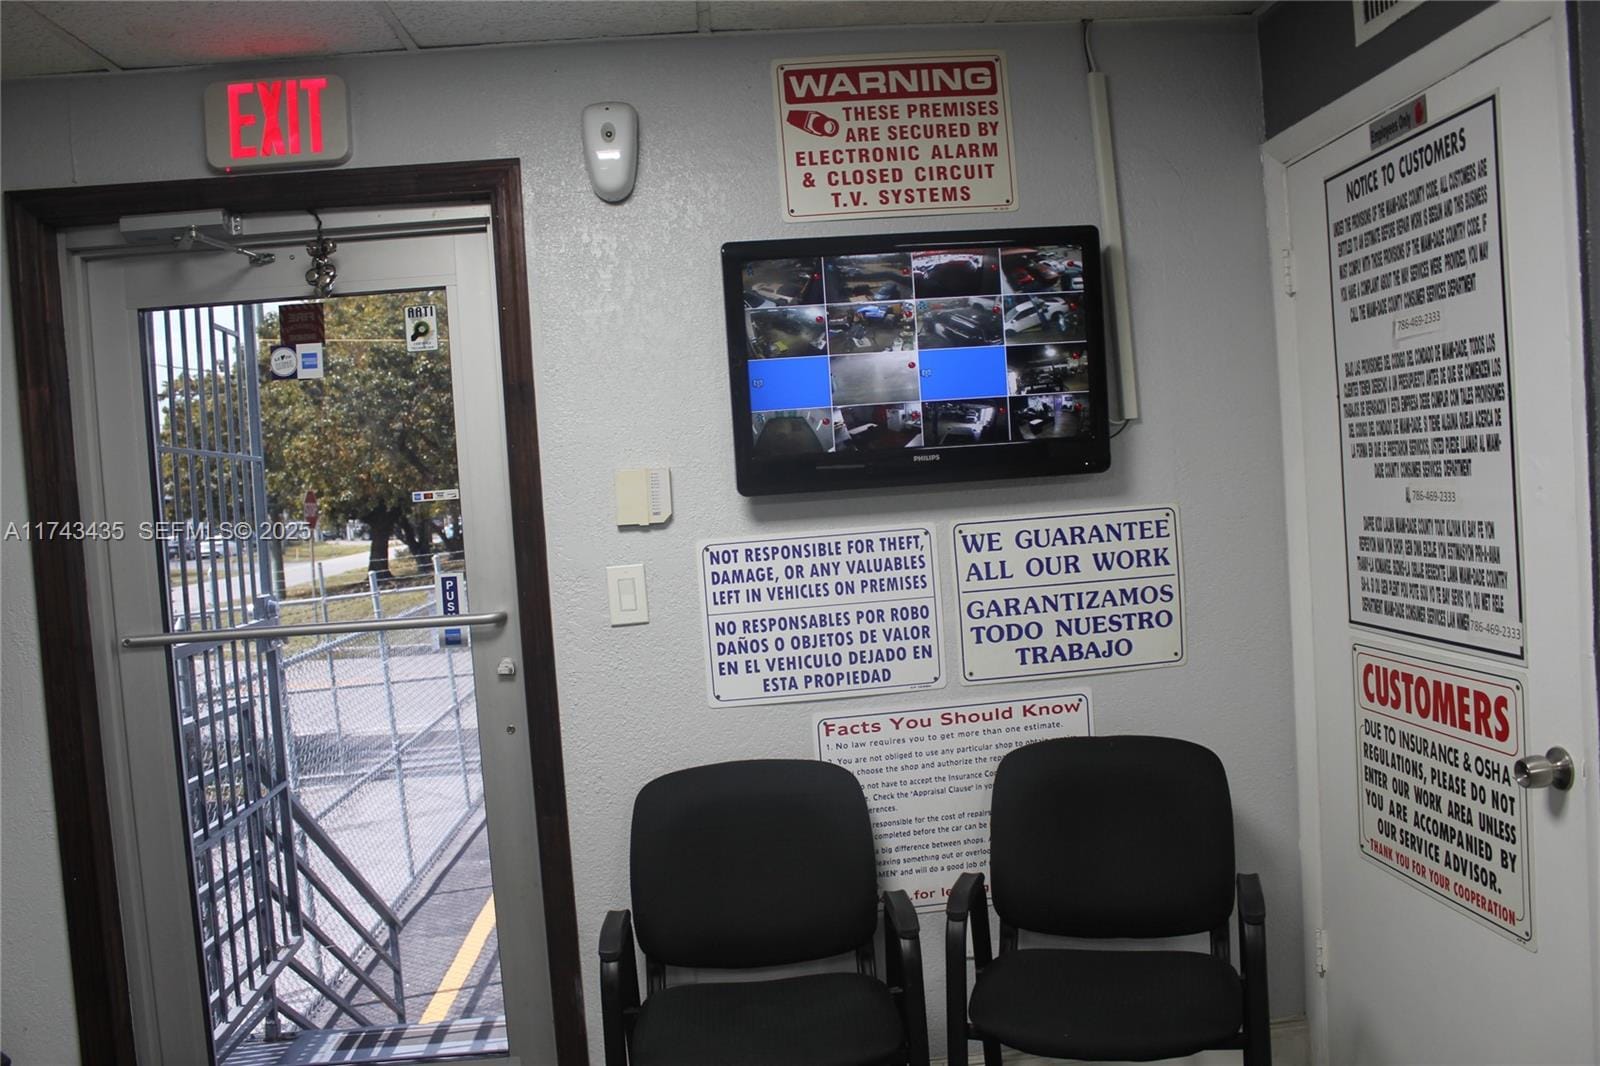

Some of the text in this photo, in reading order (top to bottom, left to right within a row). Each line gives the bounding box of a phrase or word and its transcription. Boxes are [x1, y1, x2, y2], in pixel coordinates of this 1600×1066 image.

[789, 67, 991, 98] WARNING
[227, 78, 328, 159] EXIT
[842, 100, 998, 121] THESE PREMISES
[845, 121, 998, 142] ARE SECURED BY
[795, 142, 998, 166] ELECTRONIC ALARM
[1346, 169, 1378, 203] NOTICE
[1381, 162, 1395, 186] TO
[1398, 127, 1466, 178] CUSTOMERS
[802, 163, 994, 188] & CLOSED CIRCUIT
[830, 185, 970, 207] T.V. SYSTEMS
[1397, 310, 1440, 330] 786-469-2333
[913, 454, 941, 462] PHILIPS
[1412, 490, 1456, 502] 786-469-2333
[709, 535, 924, 565] NOT RESPONSIBLE FOR THEFT,
[961, 519, 1170, 553] WE GUARANTEE
[711, 554, 925, 585] DAMAGE, OR ANY VALUABLES
[966, 547, 1170, 582] ALL OUR WORK
[446, 581, 455, 616] PUS
[712, 574, 927, 605] LEFT IN VEHICLES ON PREMISES
[966, 584, 1173, 619] GARANTIZAMOS
[715, 605, 929, 636] NO RESPONSABLES POR ROBO
[970, 609, 1173, 644] TODO NUESTRO
[1470, 619, 1521, 640] 786-469-2333
[716, 625, 930, 656] DAÑOS O OBJETOS DE VALOR
[1015, 638, 1132, 665] TRABAJO
[718, 644, 932, 676] EN EL VEHICULO DEJADO EN
[762, 668, 891, 692] ESTA PROPIEDAD
[823, 698, 1081, 736] Facts You Should Know
[1363, 663, 1509, 742] CUSTOMERS
[835, 742, 848, 750] No
[869, 737, 906, 746] requires
[940, 732, 954, 740] get
[1023, 721, 1063, 731] estimate.
[836, 758, 852, 766] You
[884, 751, 912, 760] obliged
[956, 744, 992, 754] particular
[995, 742, 1013, 751] shop
[1015, 741, 1024, 749] to
[856, 767, 883, 775] choose
[921, 761, 935, 769] and
[937, 758, 972, 767] authorize
[974, 756, 987, 764] the
[1364, 718, 1511, 787] DUE TO INSURANCE & OSHA
[909, 776, 932, 785] accept
[948, 772, 982, 781] Insurance
[1363, 742, 1515, 816] REGULATIONS, PLEASE DO NOT
[872, 792, 894, 801] Check
[896, 791, 908, 799] the
[1364, 765, 1516, 845] ENTER OUR WORK AREA UNLESS
[940, 813, 956, 821] cost
[957, 811, 965, 819] of
[1365, 788, 1516, 873] YOU ARE ACCOMPANIED BY
[894, 843, 929, 853] difference
[931, 840, 961, 848] between
[963, 837, 986, 845] shops.
[912, 828, 935, 836] before
[1377, 818, 1501, 894] OUR SERVICE ADVISOR.
[1370, 838, 1515, 926] THANK YOU FOR YOUR COOPERATION
